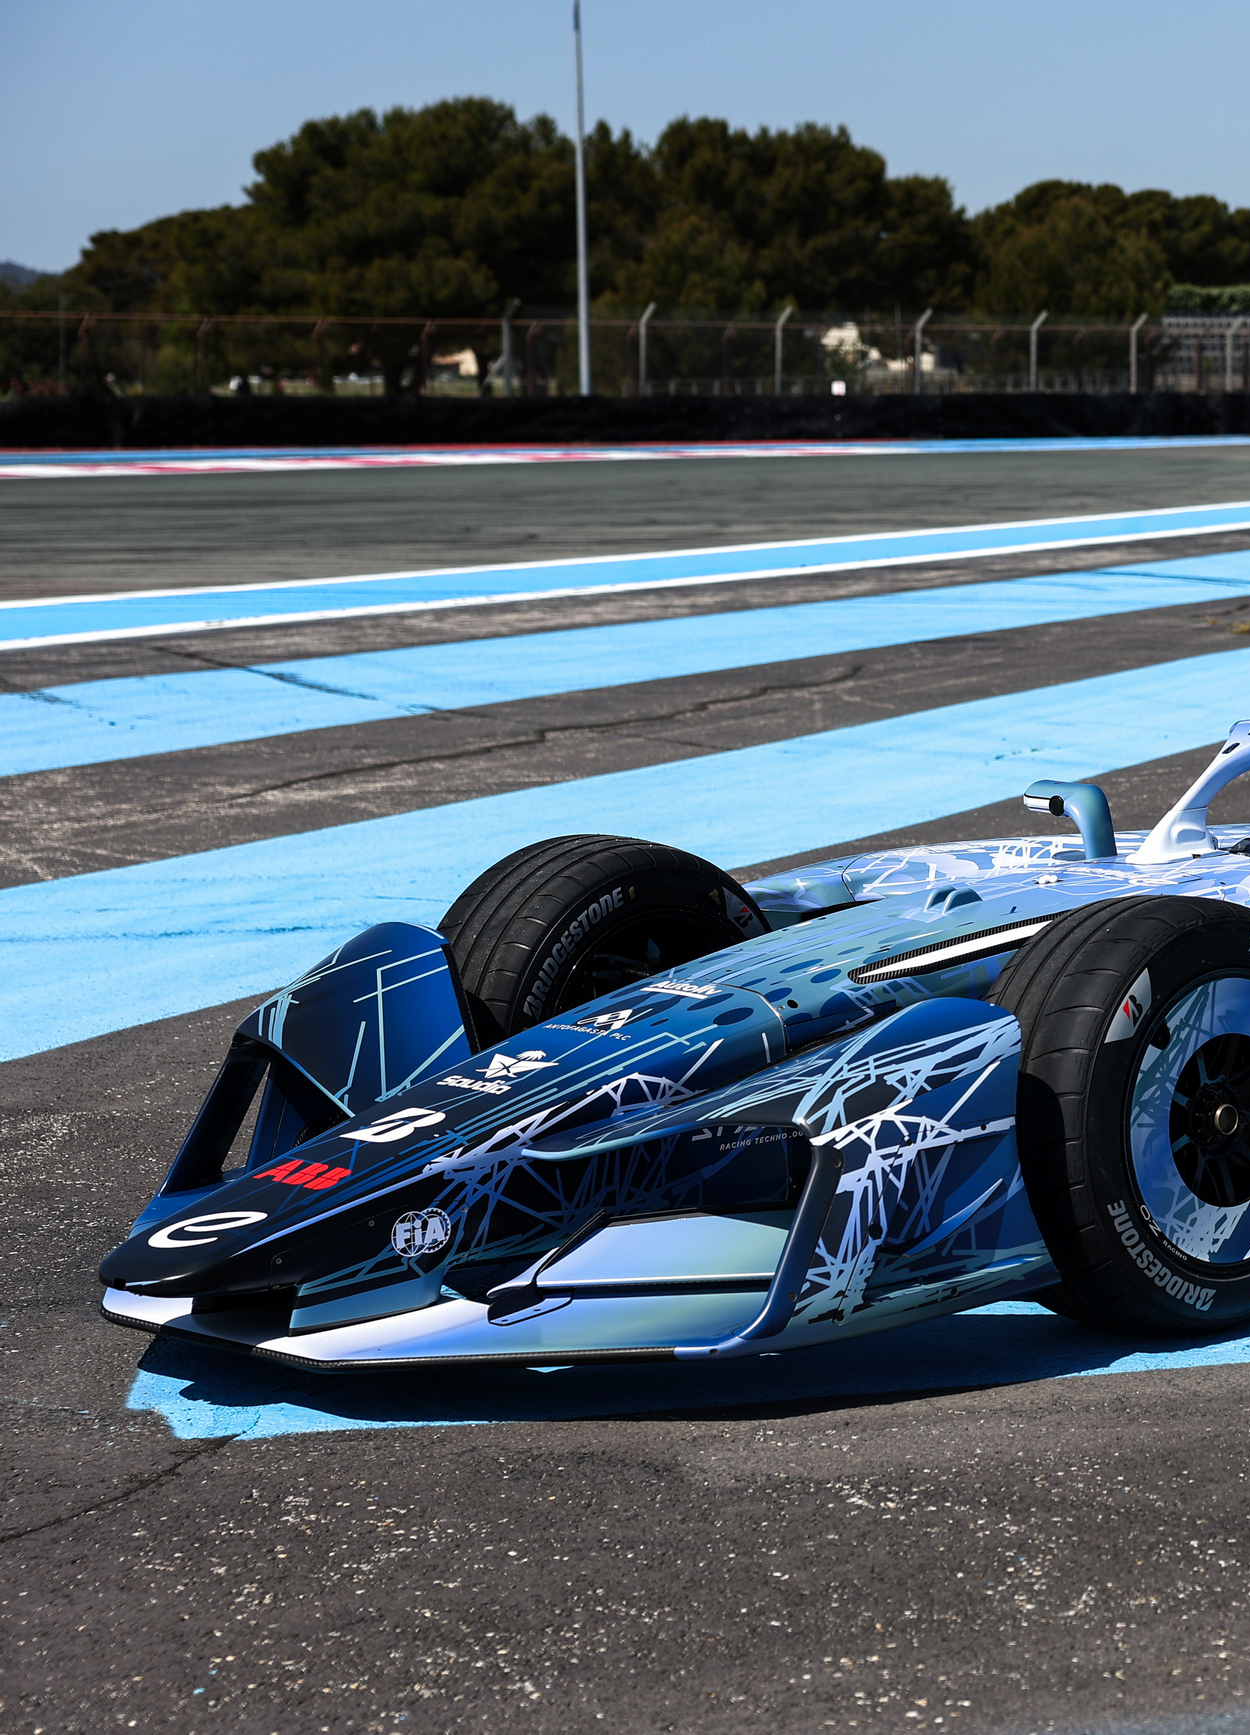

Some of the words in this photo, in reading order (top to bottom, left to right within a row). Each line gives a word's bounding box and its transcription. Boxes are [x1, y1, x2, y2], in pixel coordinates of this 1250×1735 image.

[523, 887, 624, 1021] BRIDGESTONE
[650, 980, 723, 996] Autoliv
[543, 1023, 608, 1037] ANTOFAGASTA
[609, 1032, 632, 1041] PLC
[436, 1075, 512, 1095] Saudia
[720, 1138, 752, 1151] RACING
[252, 1159, 352, 1190] ABB
[1107, 1200, 1217, 1311] BRIDGESTONE
[1162, 1240, 1188, 1261] RACING
